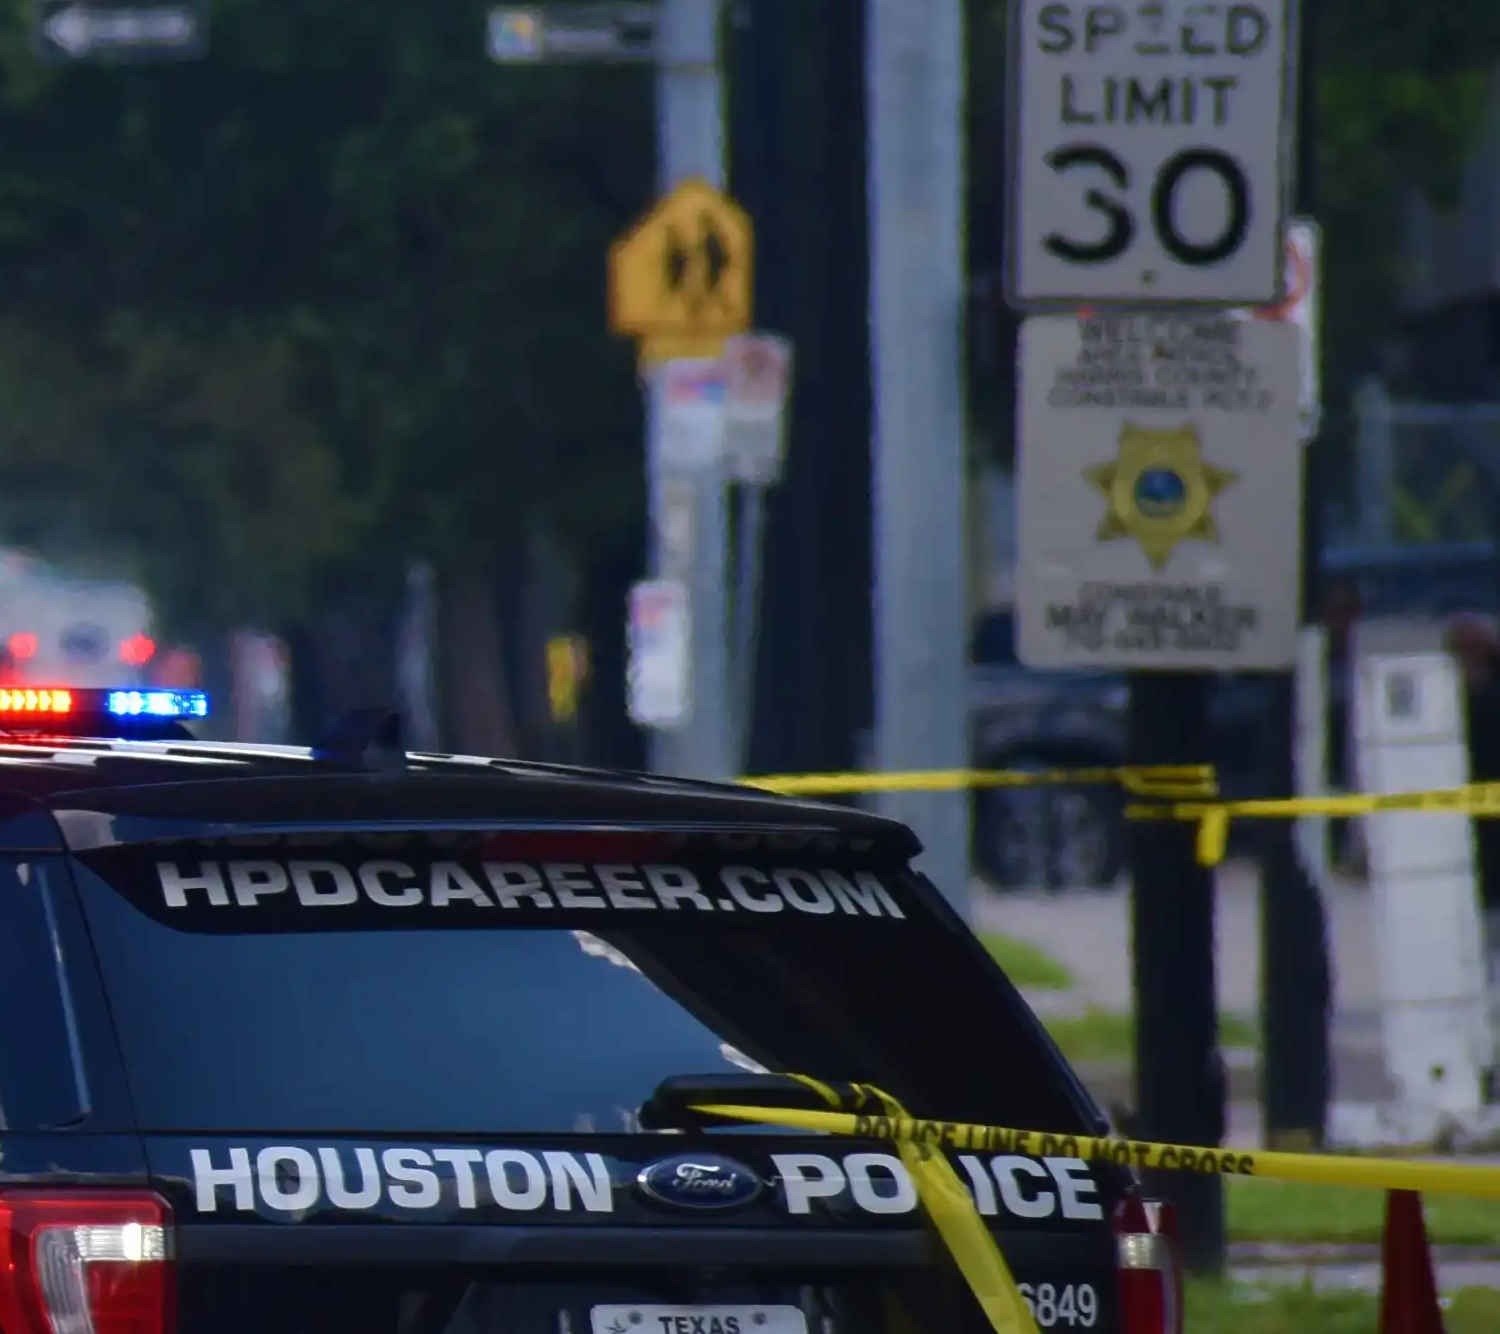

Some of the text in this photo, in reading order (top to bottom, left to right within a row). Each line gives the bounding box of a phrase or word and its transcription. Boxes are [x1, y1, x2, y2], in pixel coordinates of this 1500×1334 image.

[1060, 74, 1239, 126] LIMIT
[1044, 141, 1250, 267] 30
[155, 859, 906, 920] HPDCAREER.COM
[190, 1146, 1104, 1221] HOUSTON POICE
[671, 1161, 737, 1195] Ford
[1157, 1147, 1257, 1176] CROSS
